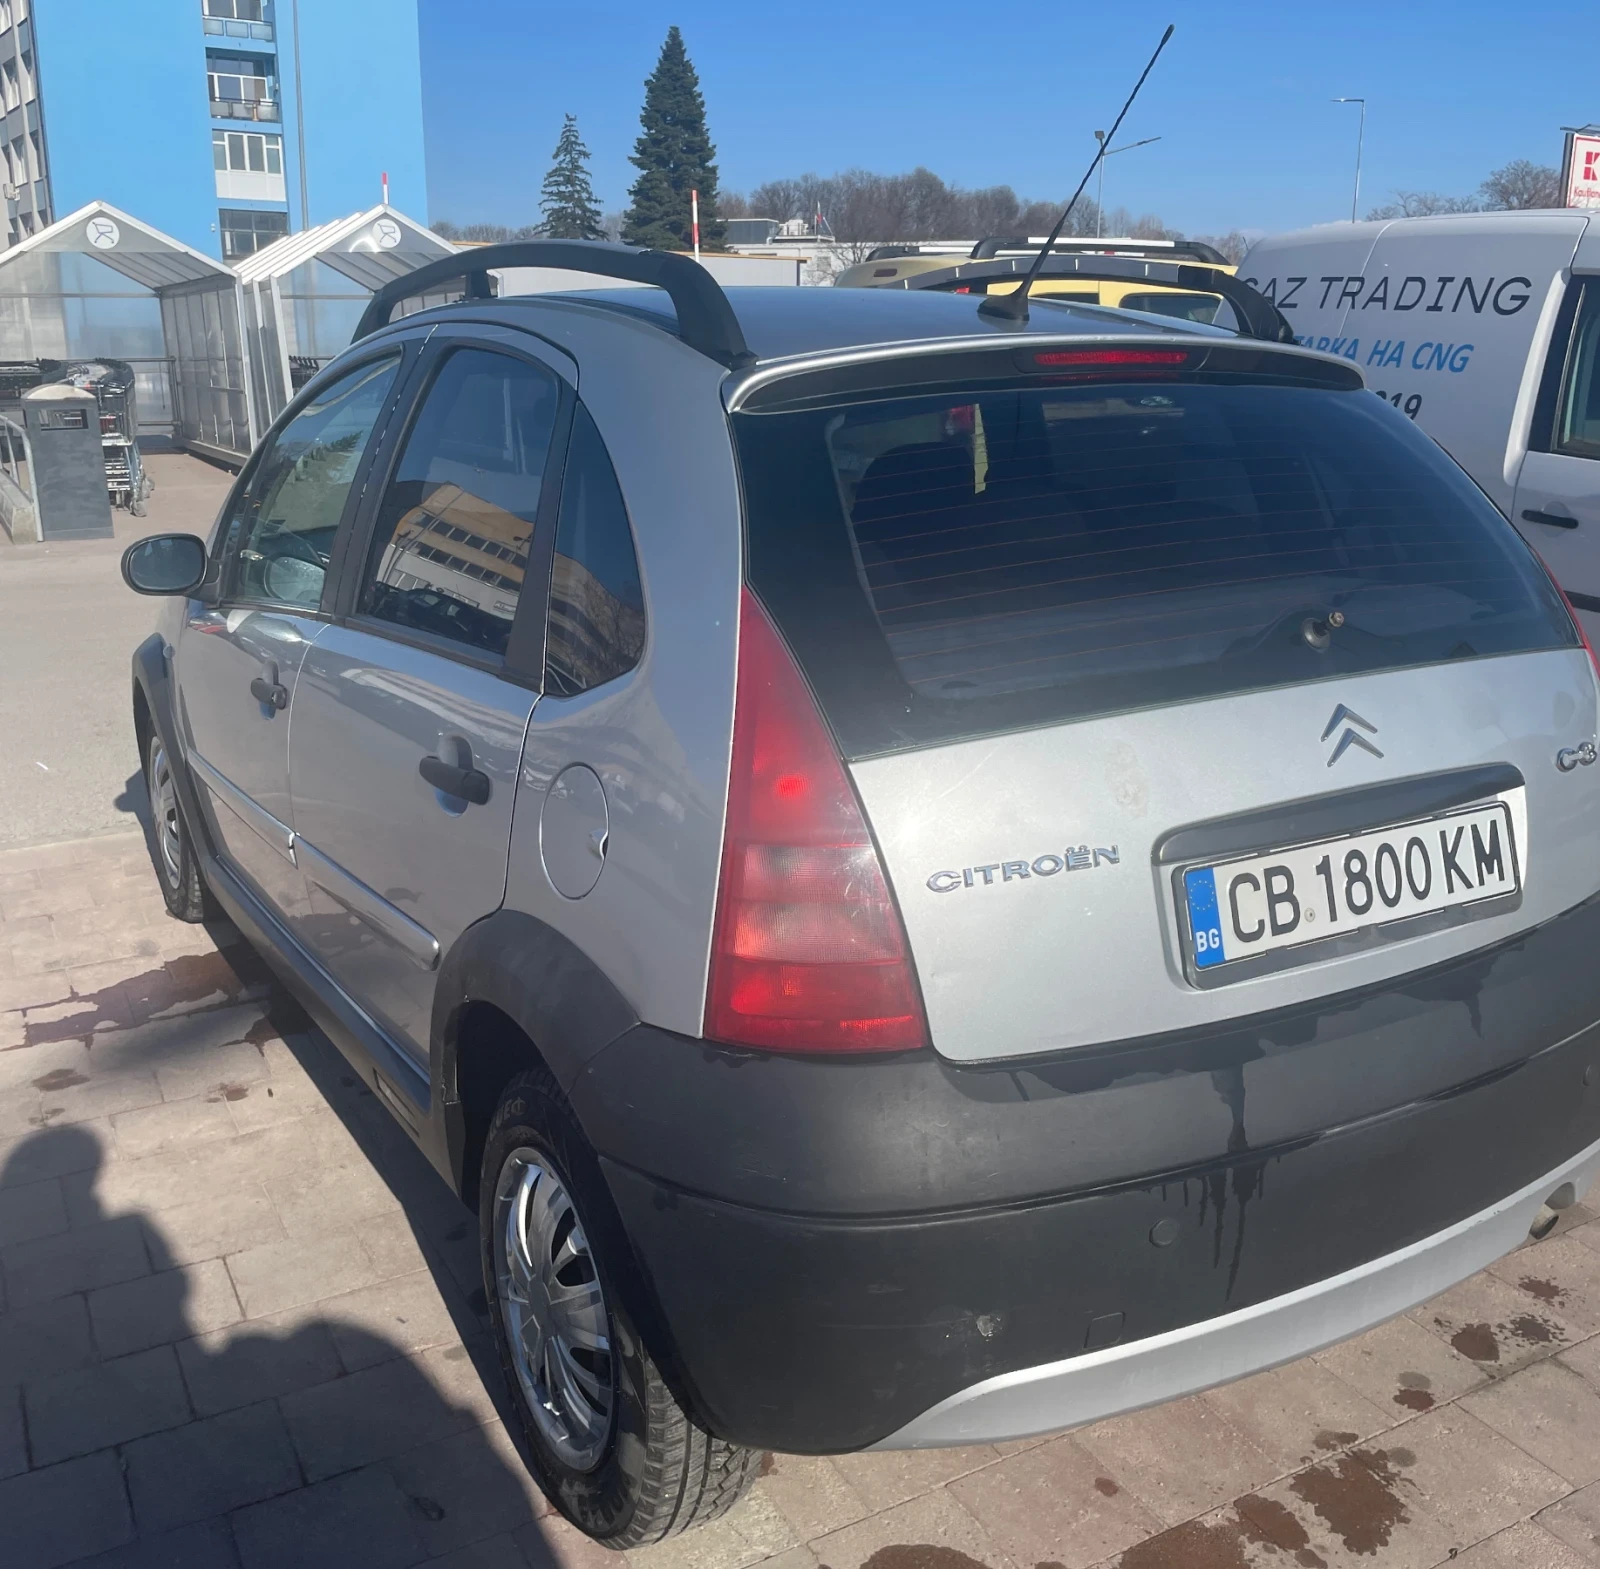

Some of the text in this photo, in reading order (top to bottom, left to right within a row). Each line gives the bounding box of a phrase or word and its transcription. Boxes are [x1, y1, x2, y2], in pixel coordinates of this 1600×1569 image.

[1319, 276, 1532, 316] TRADING
[1411, 341, 1475, 373] CNG
[926, 845, 1120, 893] CITROËN
[1228, 818, 1506, 943] CB 1800 KM
[1195, 927, 1220, 953] BG
